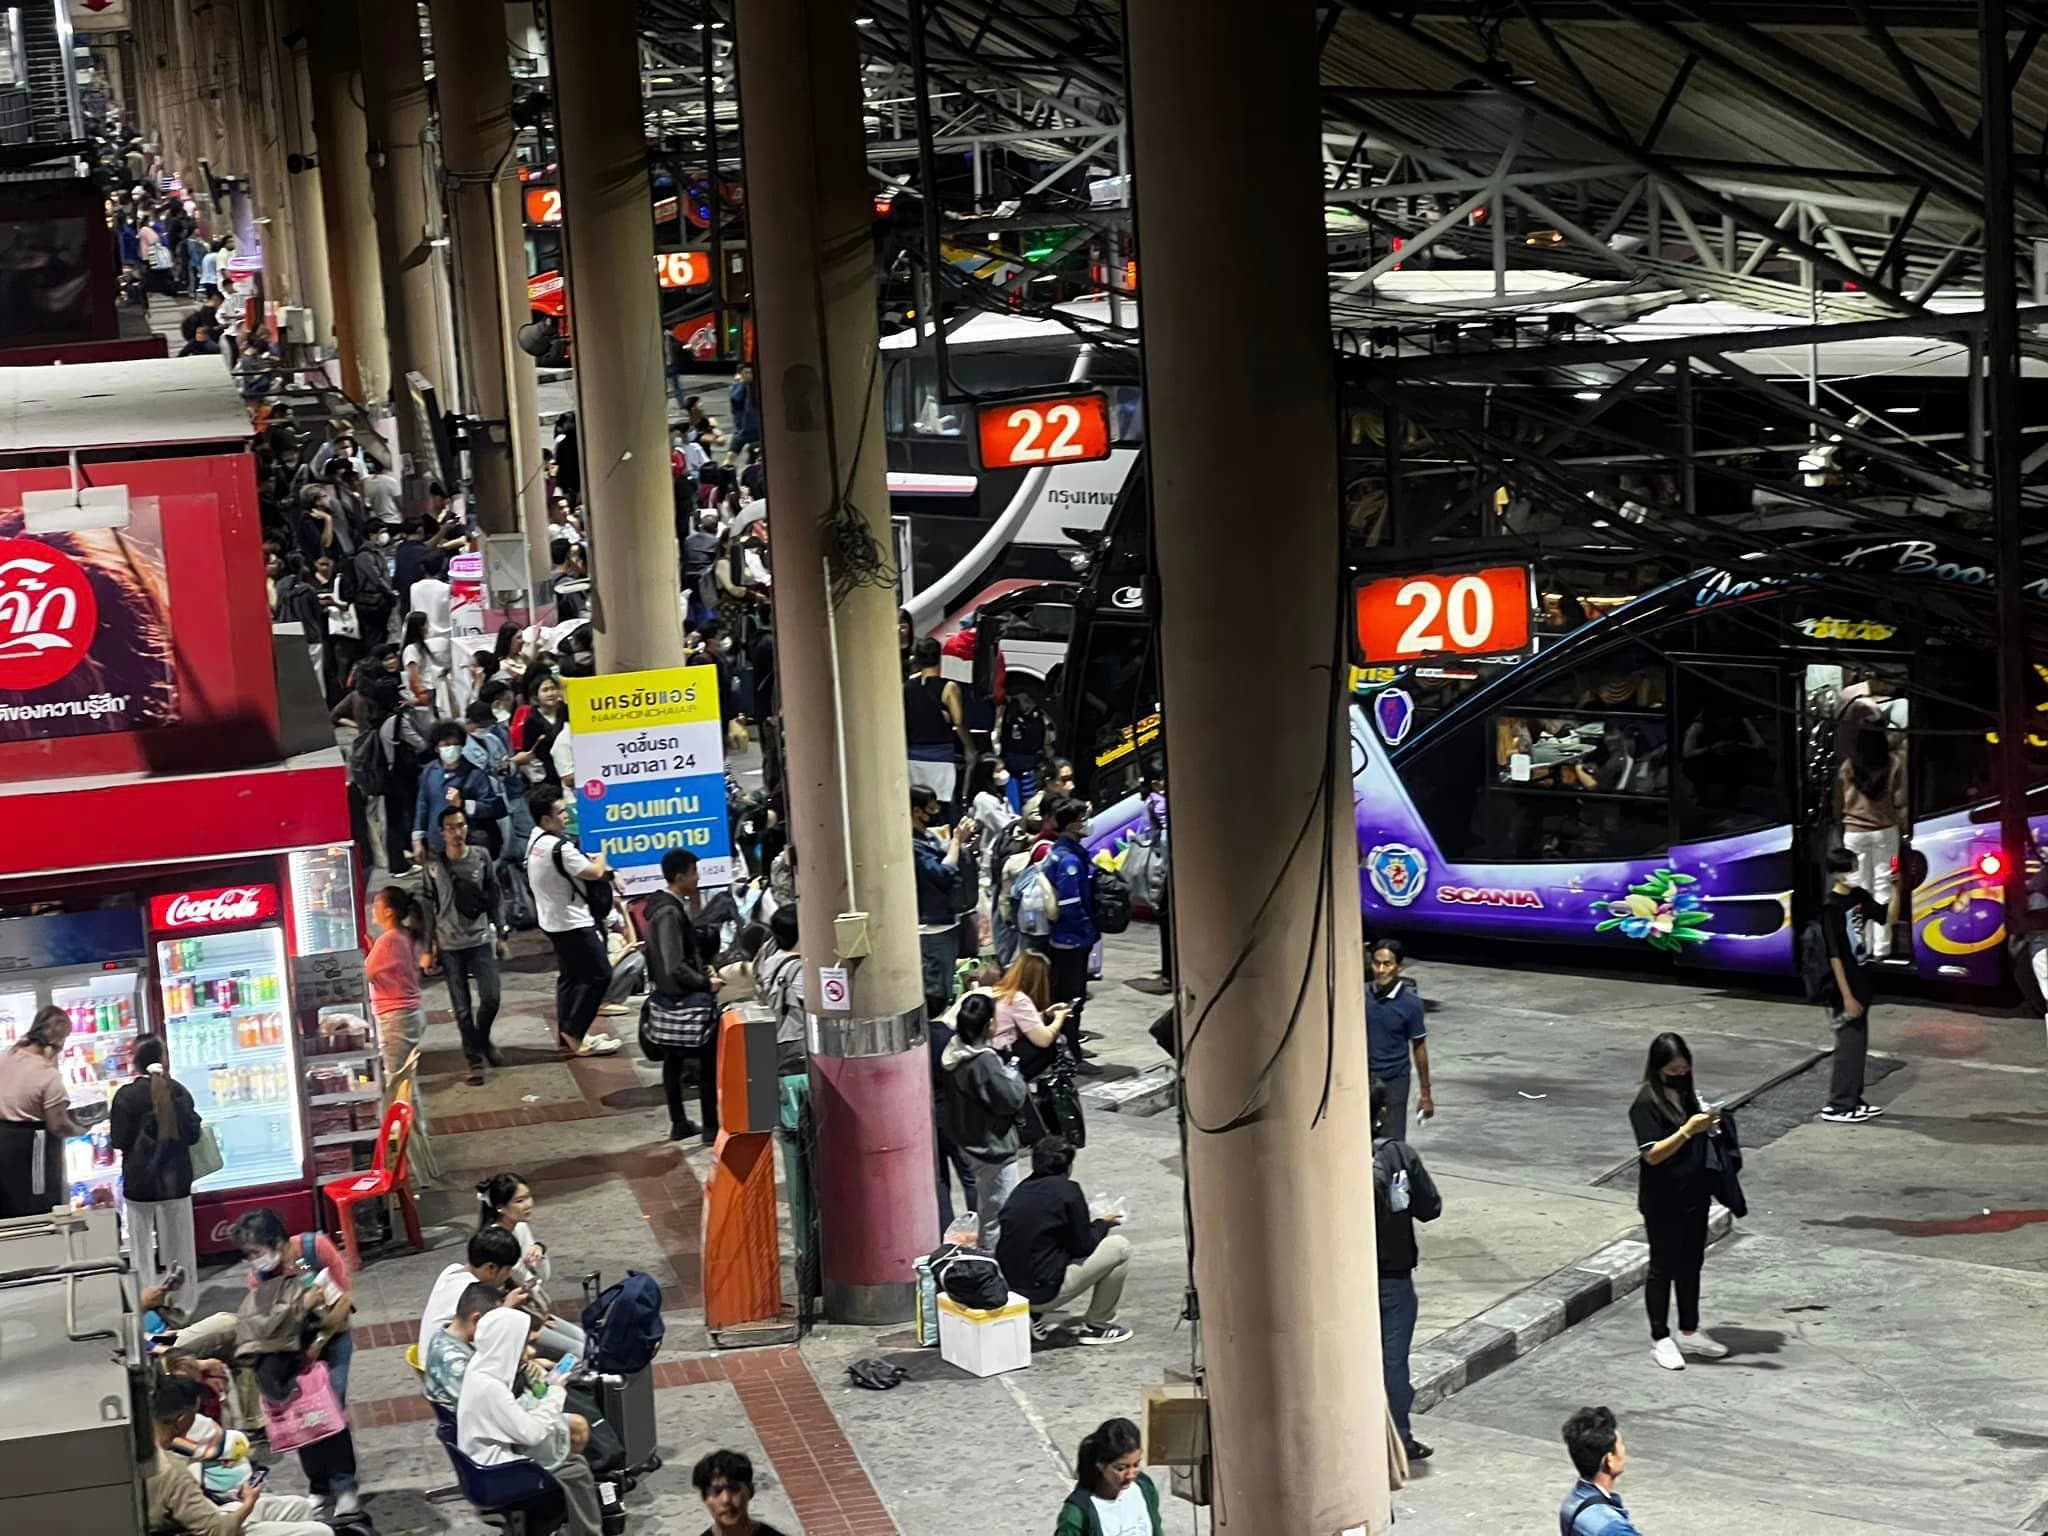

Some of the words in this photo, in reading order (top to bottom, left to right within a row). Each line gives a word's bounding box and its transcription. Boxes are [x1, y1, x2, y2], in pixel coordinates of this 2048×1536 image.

[542, 190, 562, 221] 2
[1006, 404, 1084, 462] 22
[1047, 489, 1118, 510] กรุงเทพ
[1394, 575, 1494, 654] 20
[590, 682, 697, 712] นครชัยแอร์
[616, 732, 680, 758] จุดขึ้นรถ
[601, 760, 668, 778] ชานชาลา
[673, 754, 696, 771] 24
[605, 787, 700, 822] ขอนแก่น
[600, 826, 711, 856] หนองคาย
[165, 887, 263, 926] Coca-Cola
[1436, 885, 1545, 909] SCANIA
